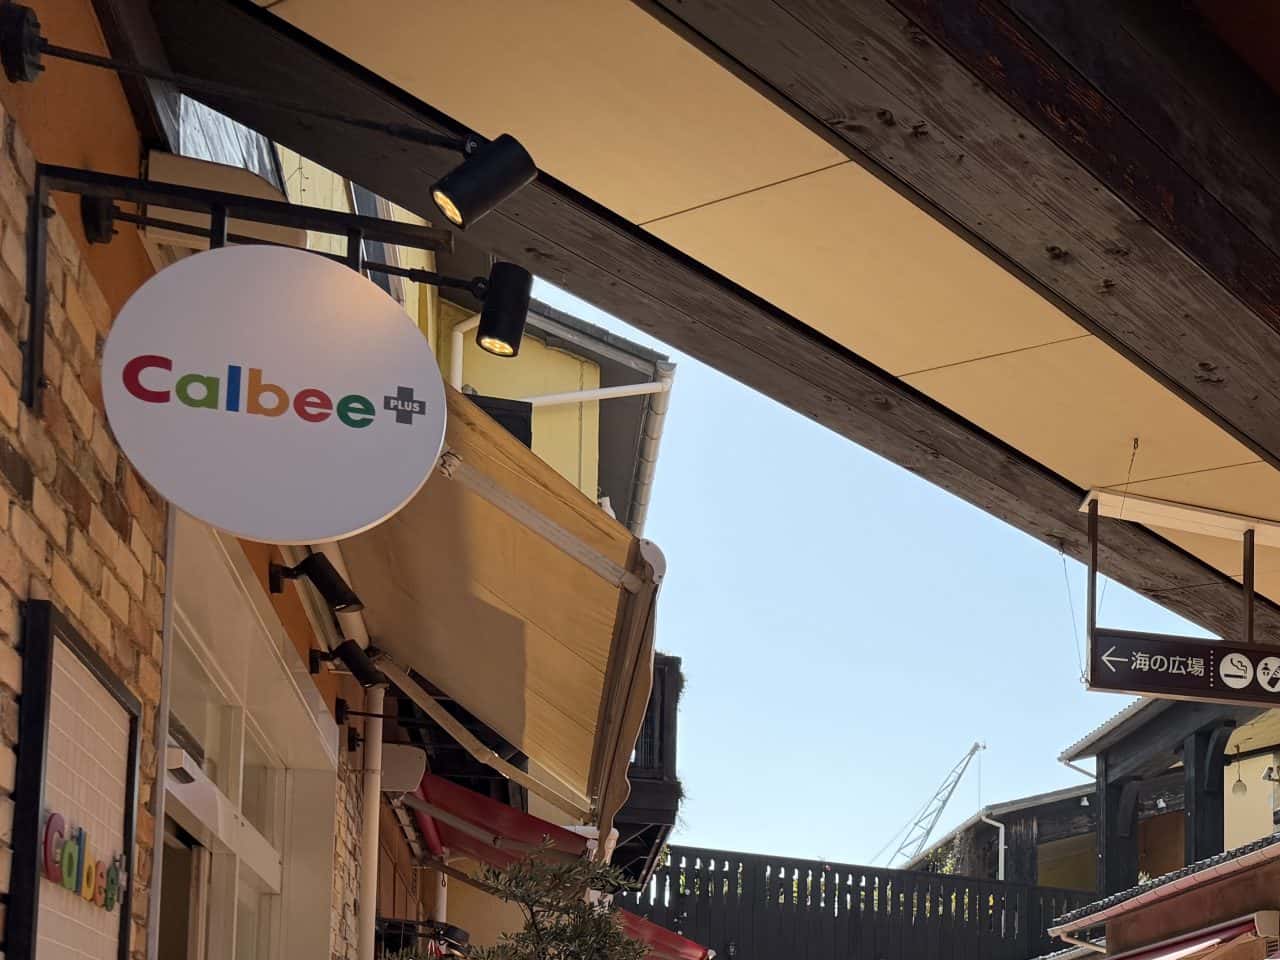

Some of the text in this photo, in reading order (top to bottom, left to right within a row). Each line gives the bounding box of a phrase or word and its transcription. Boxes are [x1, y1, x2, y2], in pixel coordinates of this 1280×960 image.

[121, 353, 376, 429] Calbee
[389, 398, 421, 413] PLUS
[1130, 651, 1206, 677] 海の広場
